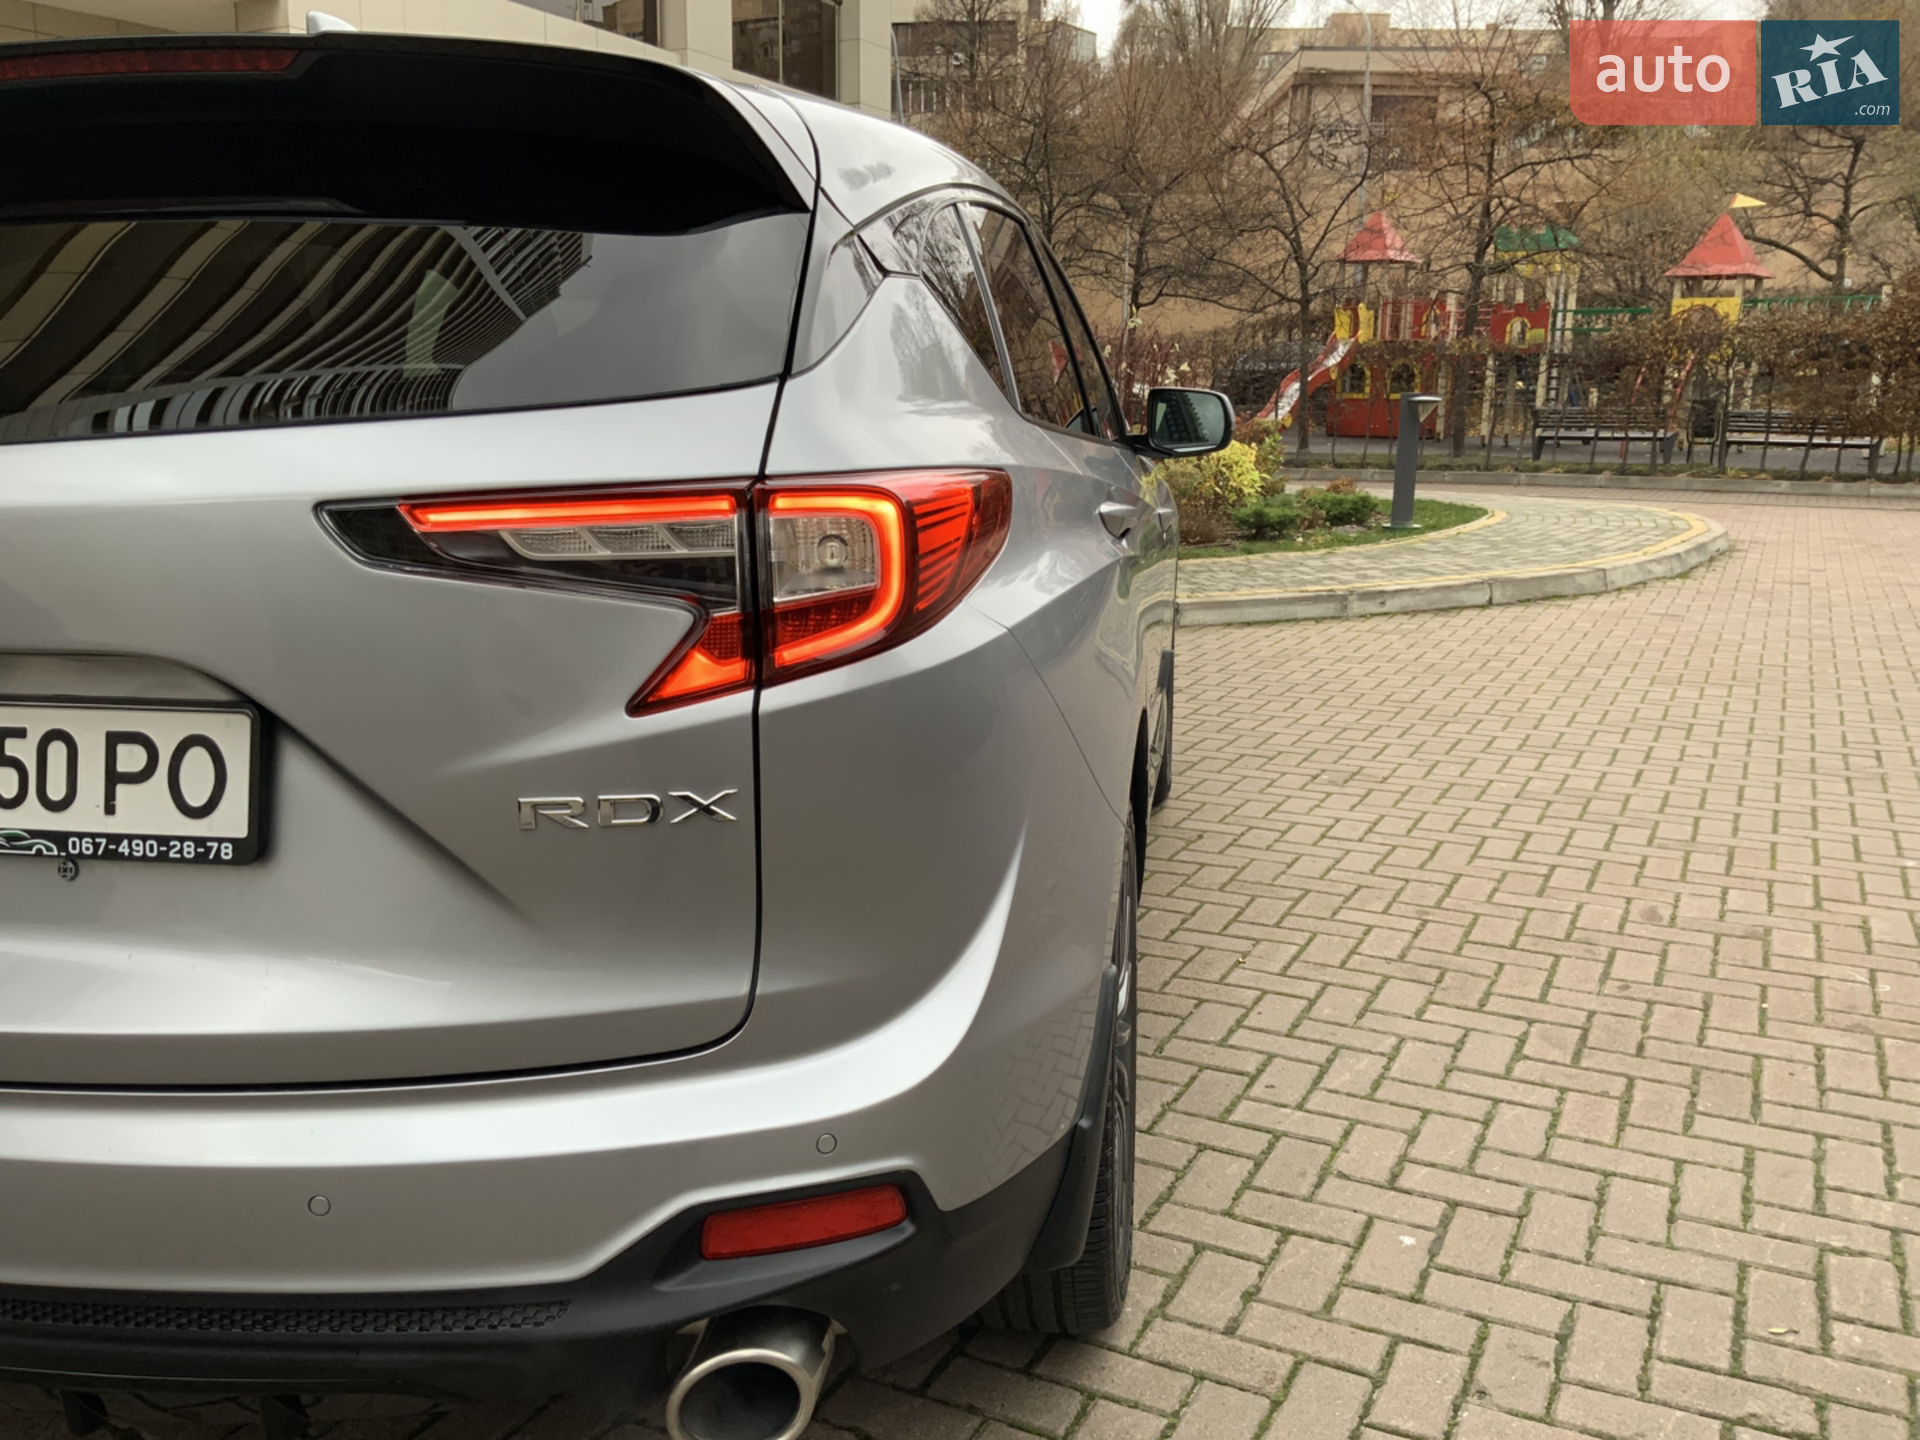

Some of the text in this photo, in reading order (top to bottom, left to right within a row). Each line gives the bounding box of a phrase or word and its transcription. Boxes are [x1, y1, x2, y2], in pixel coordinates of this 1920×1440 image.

[104, 730, 227, 820] PO
[518, 788, 738, 830] RDX
[68, 836, 234, 860] 067-490-28-78
